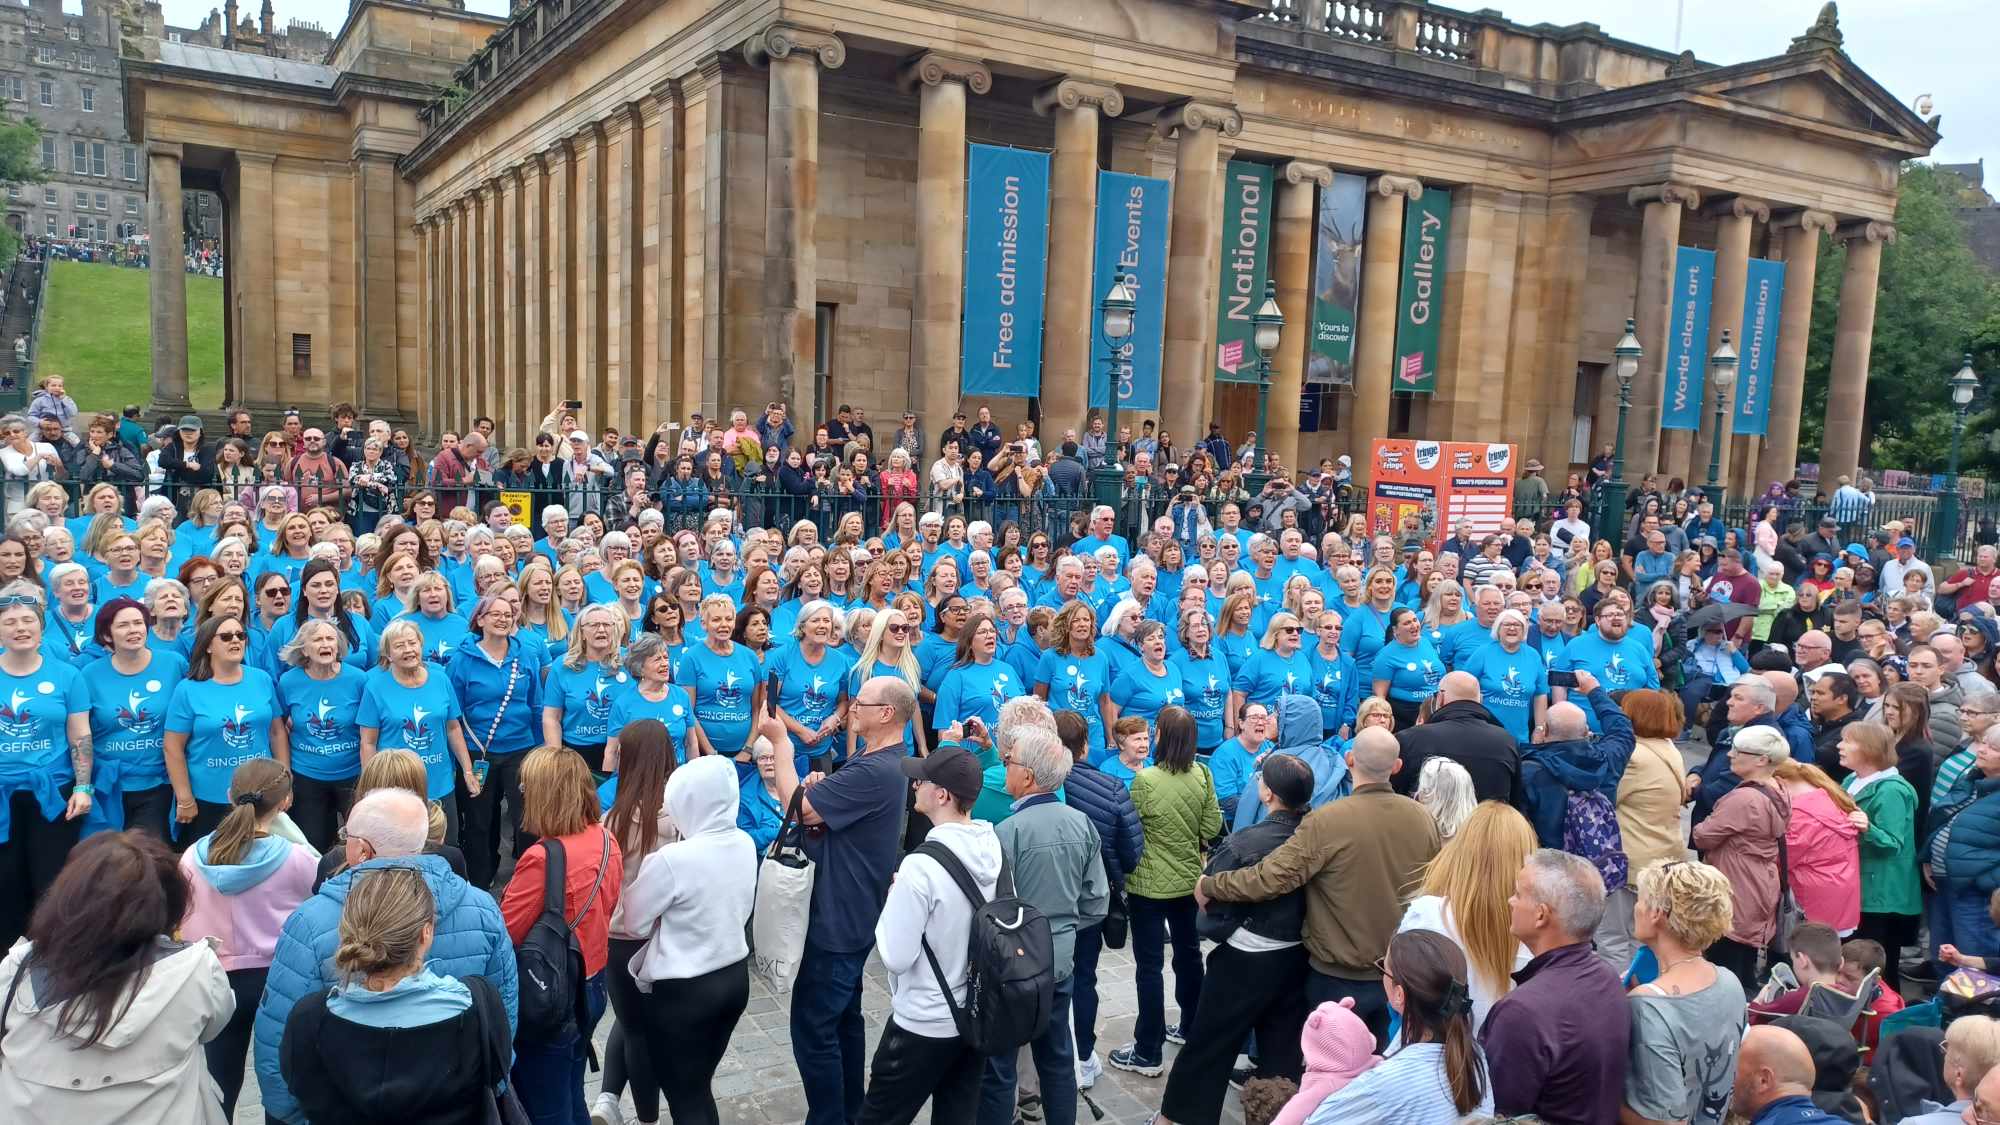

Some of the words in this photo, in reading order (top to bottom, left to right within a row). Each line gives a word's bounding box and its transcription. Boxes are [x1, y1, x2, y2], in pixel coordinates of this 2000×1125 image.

[996, 176, 1020, 305] admission
[1121, 186, 1143, 268] Events
[1227, 174, 1261, 320] National
[1410, 210, 1441, 325] Gallery
[992, 312, 1014, 369] Free
[1318, 331, 1349, 341] discover
[1319, 321, 1341, 332] Yours
[1341, 324, 1350, 333] to
[1673, 300, 1696, 412] World-class
[1689, 265, 1700, 295] art
[1750, 279, 1769, 370] admission
[1743, 374, 1758, 415] Free
